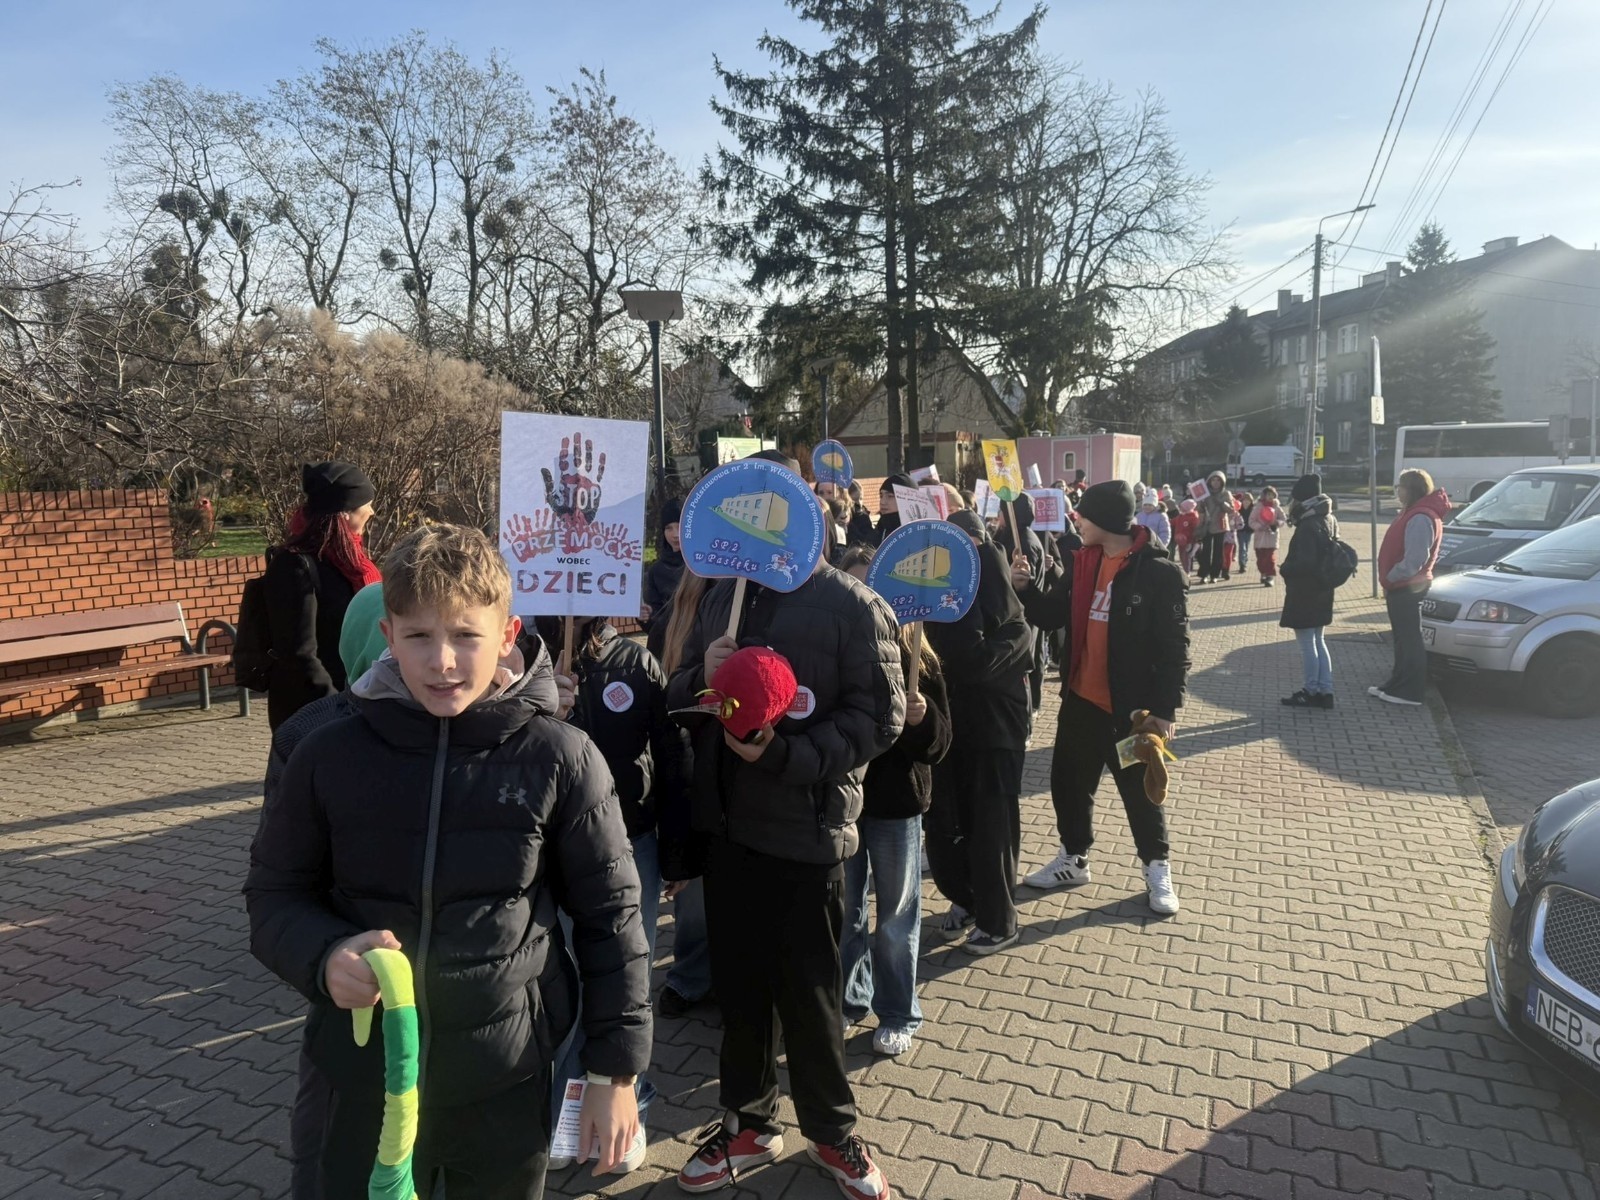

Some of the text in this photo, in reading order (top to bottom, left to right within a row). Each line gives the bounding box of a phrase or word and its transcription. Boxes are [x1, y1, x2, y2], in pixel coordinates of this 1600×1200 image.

[553, 483, 601, 510] STOP
[690, 469, 730, 509] Podstawowa
[743, 462, 749, 470] 2
[754, 462, 767, 471] im.
[807, 502, 821, 563] Broniewskiego
[731, 543, 739, 551] 2
[870, 537, 898, 579] Podstawowa
[556, 557, 591, 565] WOBEC
[517, 570, 627, 595] DZIECI
[1527, 1004, 1535, 1016] PL
[1537, 992, 1583, 1047] NEB
